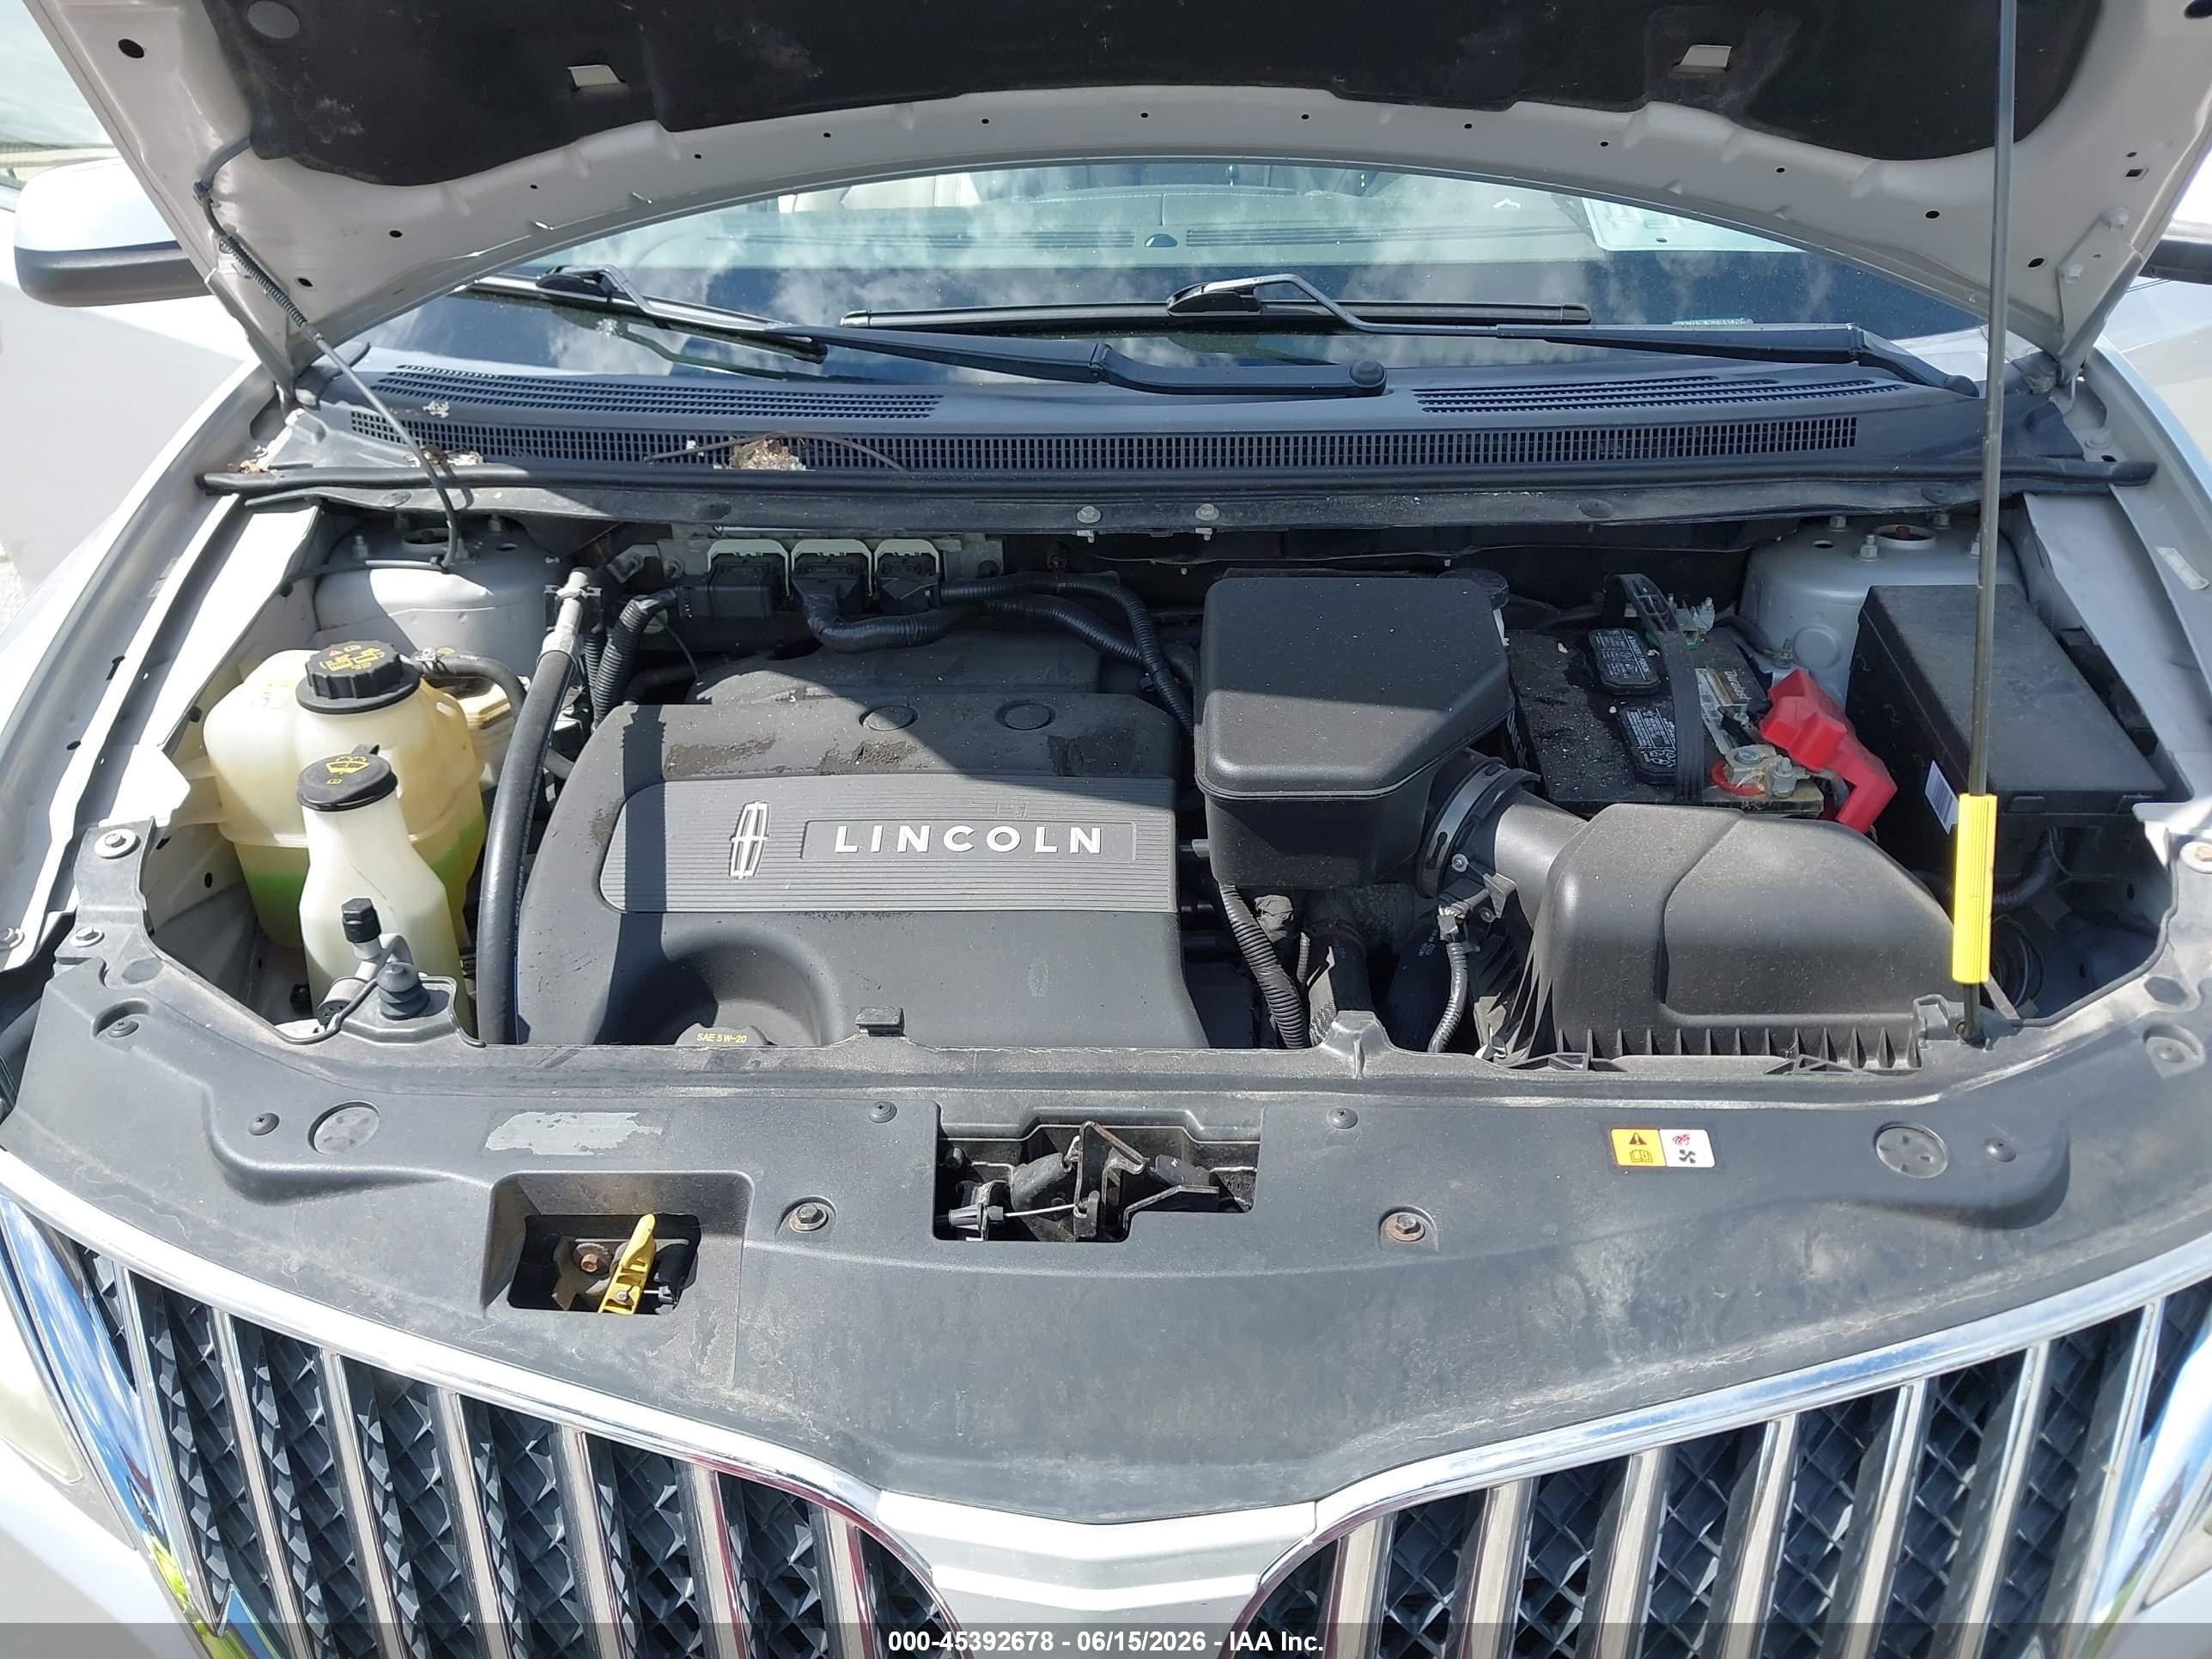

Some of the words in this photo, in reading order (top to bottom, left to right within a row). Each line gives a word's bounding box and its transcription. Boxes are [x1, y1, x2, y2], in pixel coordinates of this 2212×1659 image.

[1723, 669, 1753, 702] Duralast
[834, 824, 1103, 854] LINCOLN
[696, 1032, 715, 1042] SAE
[716, 1033, 748, 1044] 5W-20
